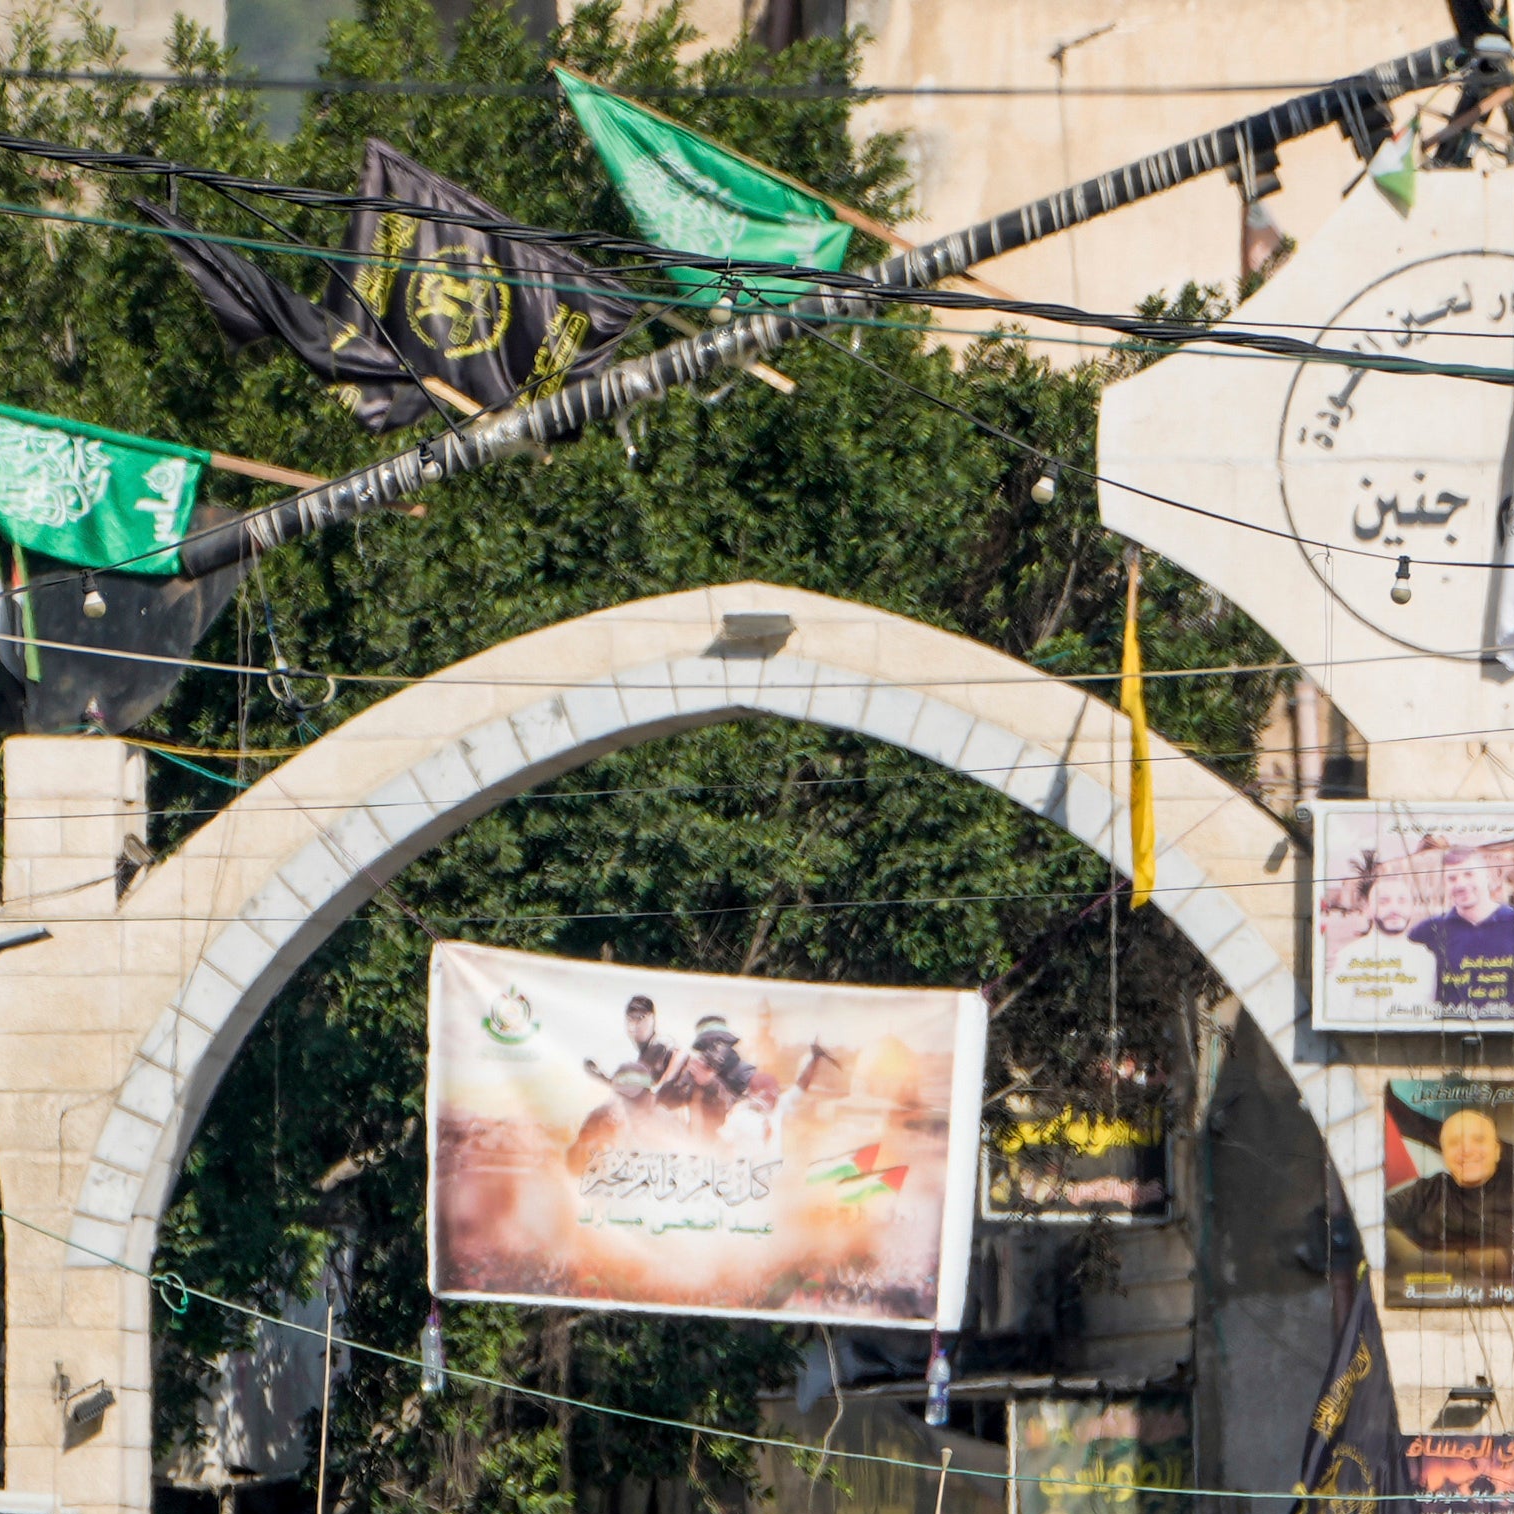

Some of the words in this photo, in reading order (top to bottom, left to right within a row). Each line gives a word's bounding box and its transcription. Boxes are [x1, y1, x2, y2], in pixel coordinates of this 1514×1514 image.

[1352, 470, 1470, 547] جنين
[729, 1214, 774, 1235] عيد
[1404, 1436, 1494, 1463] المساف
